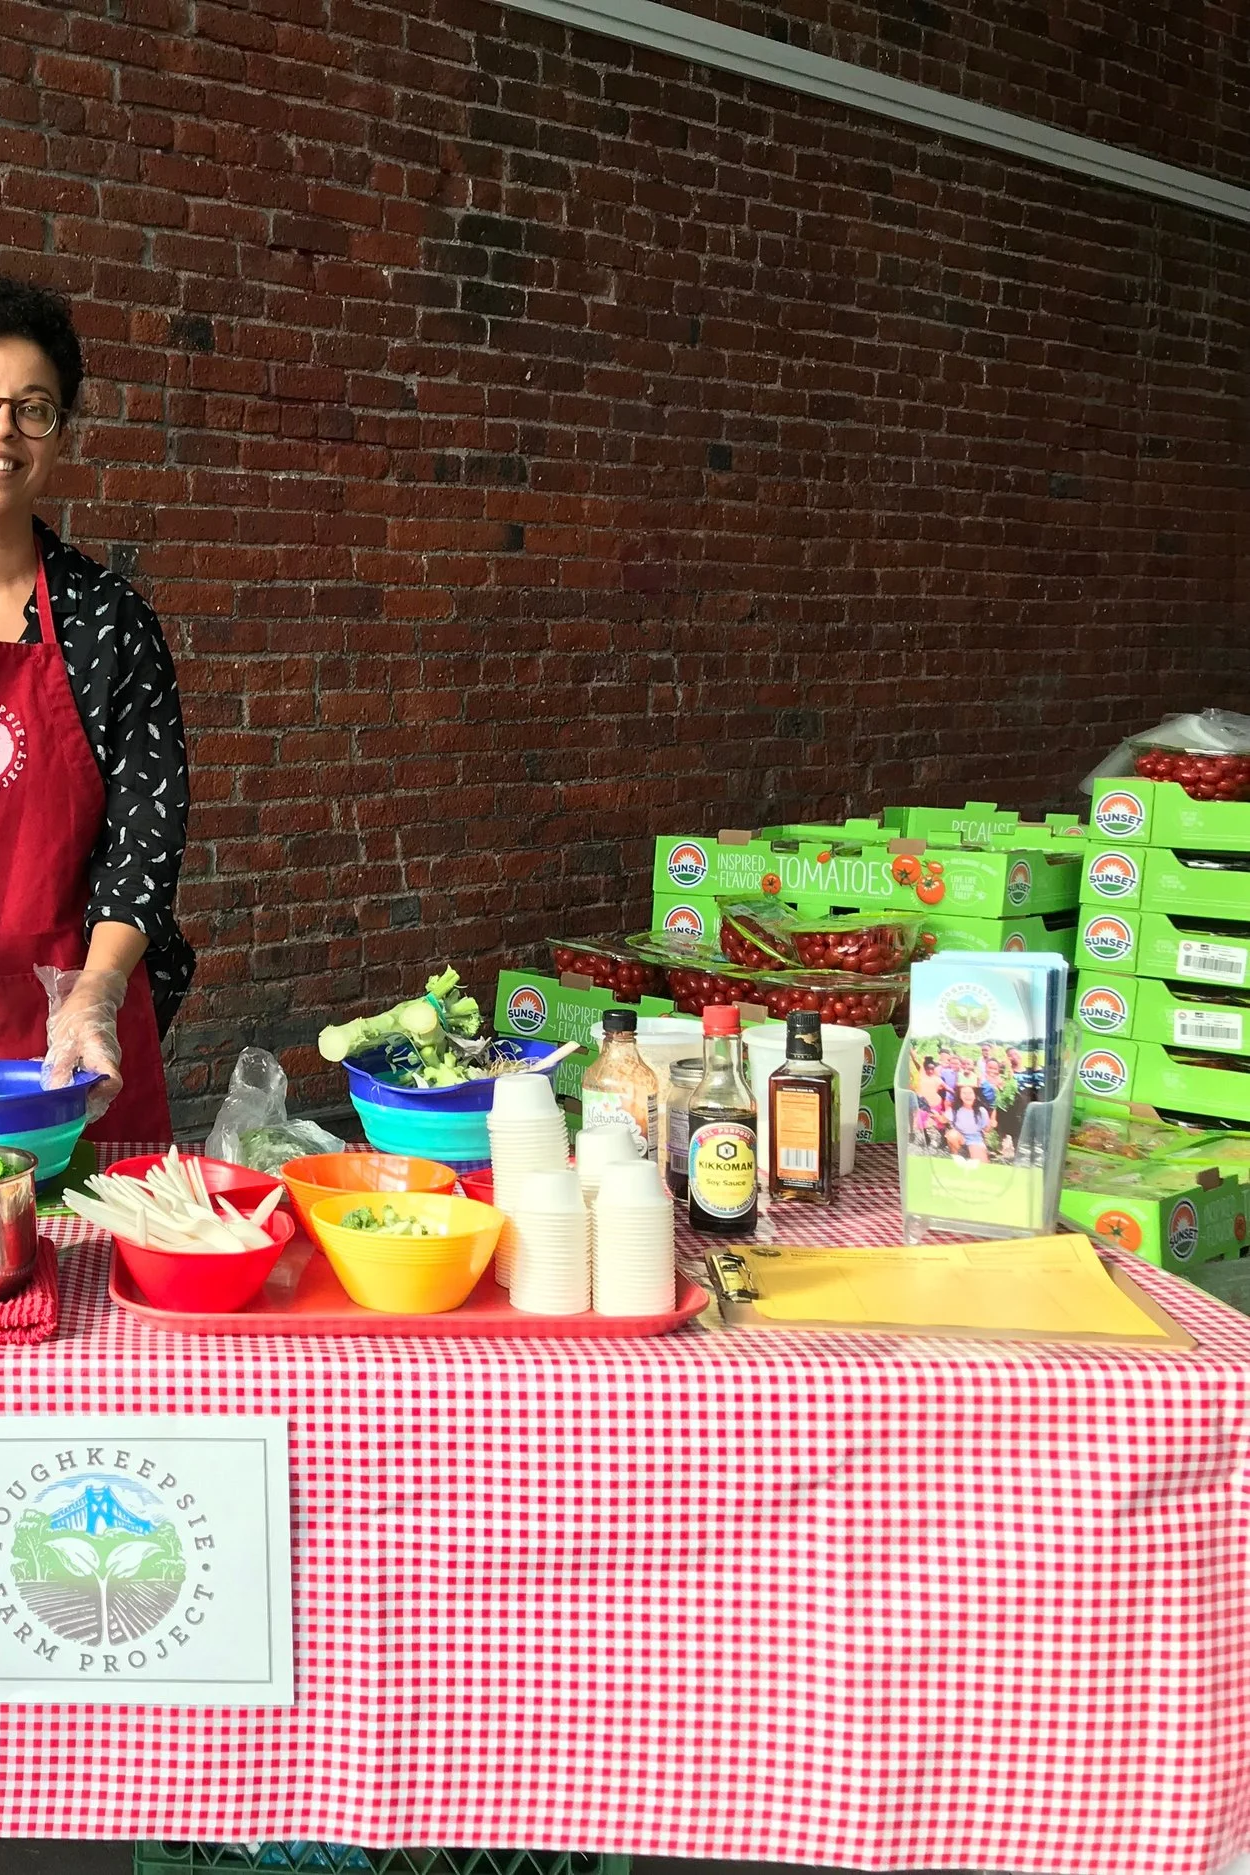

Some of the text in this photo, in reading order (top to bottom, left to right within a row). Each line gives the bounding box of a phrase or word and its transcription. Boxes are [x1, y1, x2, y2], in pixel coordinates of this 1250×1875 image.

[1096, 813, 1143, 826] SUNSET
[668, 864, 707, 877] SUNSET
[717, 853, 894, 897] INSPIRED TOMATOES
[719, 870, 761, 890] FLAVOR
[1008, 882, 1031, 894] SUNSET
[1089, 873, 1137, 889] SUNSET
[1084, 937, 1132, 951] SUNSET
[508, 1008, 547, 1024] SUNSET
[1079, 1008, 1126, 1024] SUNSET
[558, 1020, 596, 1044] FLAVO
[556, 1062, 586, 1083] INSPI
[1079, 1069, 1126, 1087] SUNSET
[558, 1080, 582, 1101] FLAV
[586, 1106, 631, 1125] Nature's
[698, 1160, 753, 1171] KIKKOMAN
[705, 1178, 720, 1187] Soy
[1169, 1227, 1199, 1248] SUNSET
[79, 1584, 215, 1674] PROJECT
